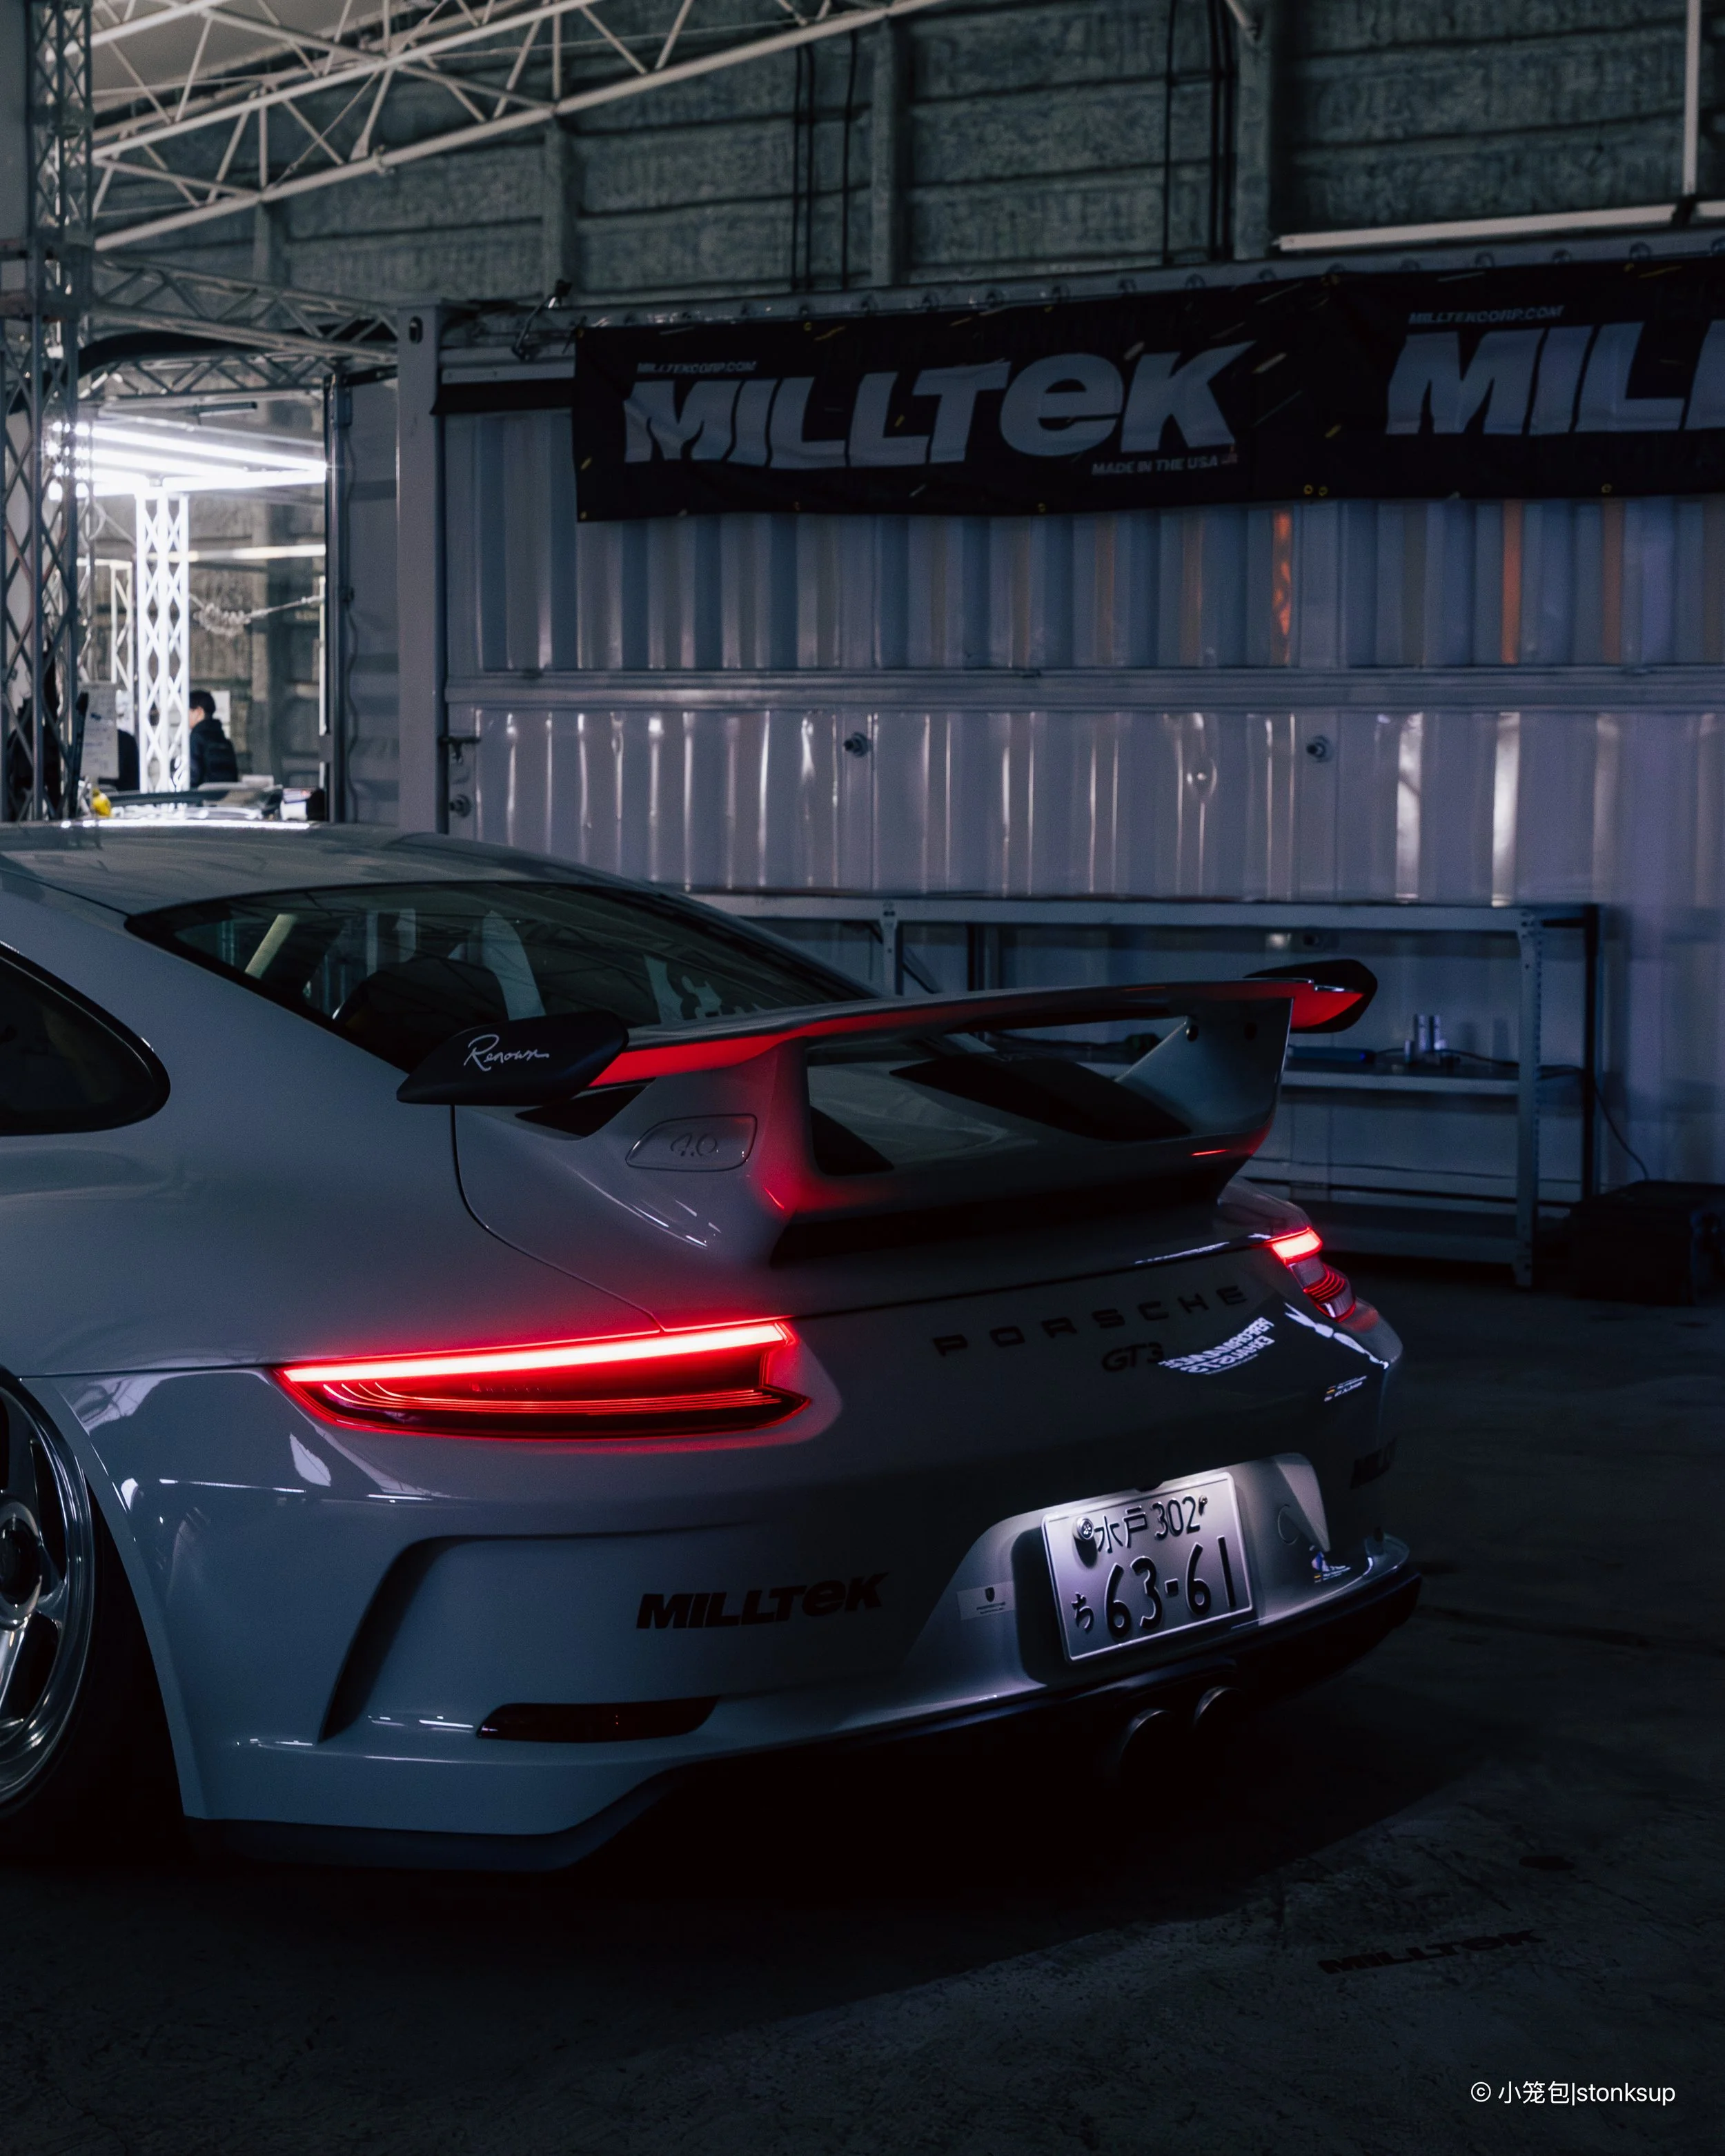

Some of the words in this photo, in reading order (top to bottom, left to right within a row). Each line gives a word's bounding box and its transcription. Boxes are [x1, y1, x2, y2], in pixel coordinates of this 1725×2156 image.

[1091, 461, 1134, 476] MADE
[1137, 460, 1152, 472] IN
[1155, 458, 1185, 472] THE
[1187, 455, 1219, 470] USA
[933, 1285, 1248, 1356] PORSCHE
[1101, 1342, 1165, 1372] GT3
[1094, 1505, 1148, 1554] 水戸
[1150, 1496, 1201, 1540] 302
[1071, 1592, 1095, 1633] ち
[1105, 1534, 1237, 1639] 63-61
